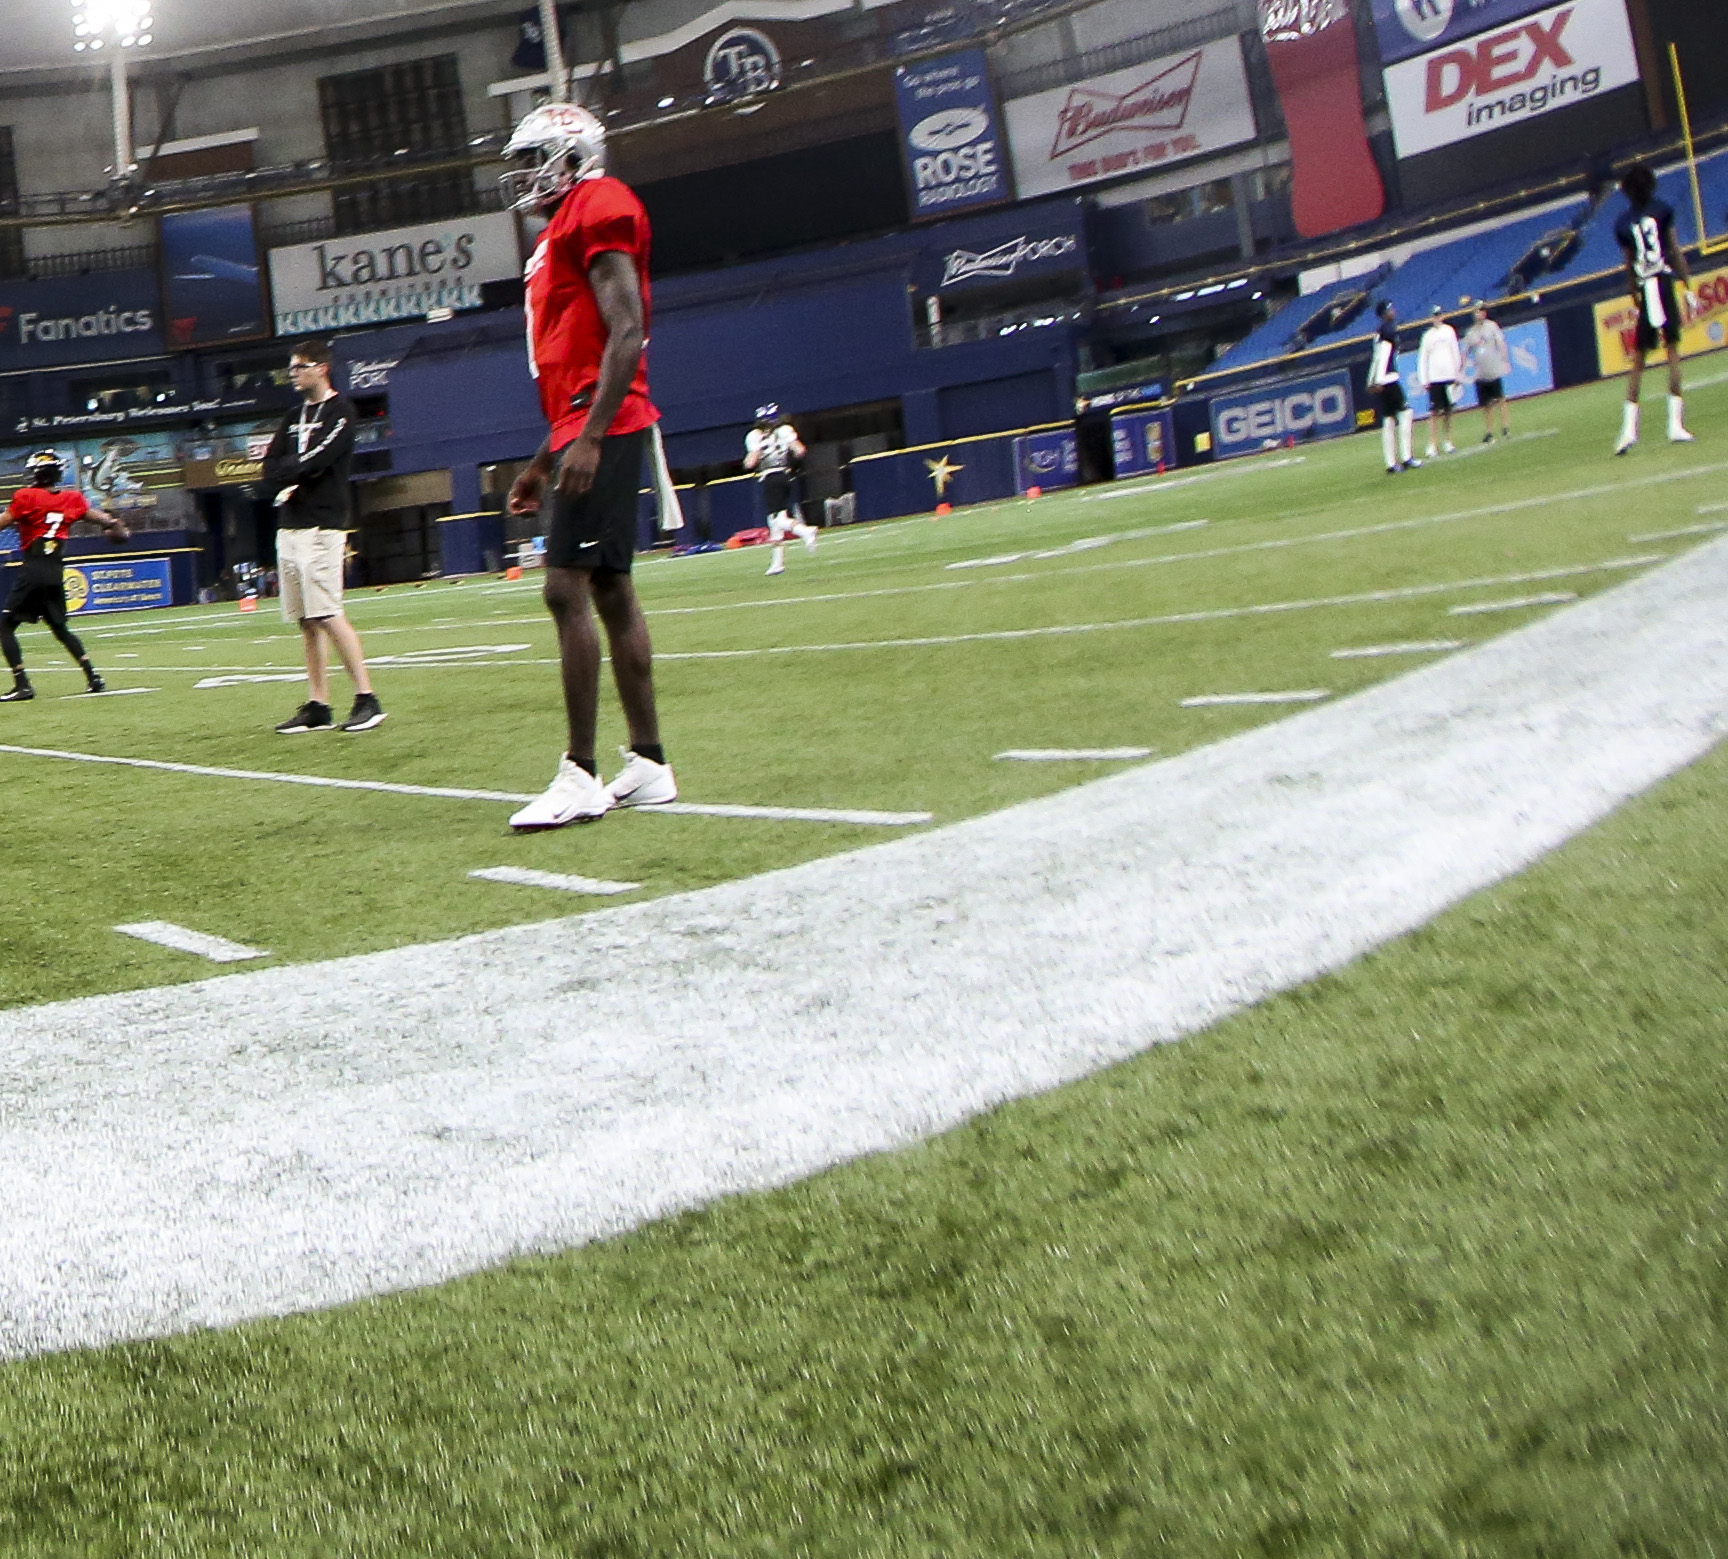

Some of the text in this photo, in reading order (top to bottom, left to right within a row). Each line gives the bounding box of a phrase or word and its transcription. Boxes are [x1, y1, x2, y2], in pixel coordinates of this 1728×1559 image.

[1425, 7, 1575, 114] DEX
[1467, 66, 1601, 127] imaging
[913, 141, 998, 189] ROSE
[312, 233, 475, 290] kane's
[19, 304, 152, 344] Fanatics
[1219, 385, 1347, 441] GEICO
[43, 512, 64, 538] 7
